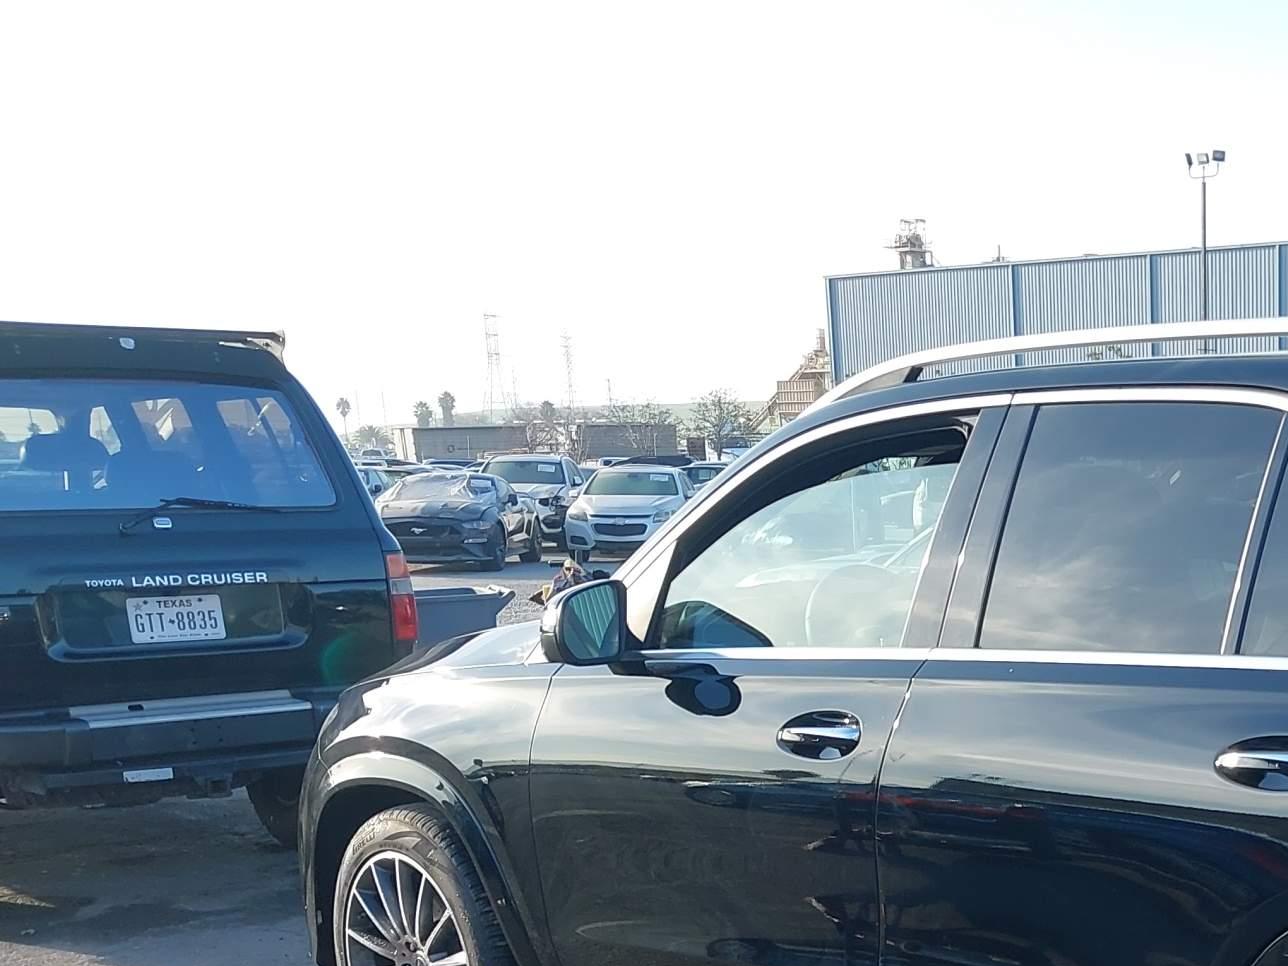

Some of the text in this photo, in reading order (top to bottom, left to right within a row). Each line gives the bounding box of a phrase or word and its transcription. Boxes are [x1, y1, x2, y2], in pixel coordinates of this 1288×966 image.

[85, 571, 268, 588] TOYOTA LAND CRUISER
[156, 599, 193, 609] TEXAS
[134, 610, 218, 633] GTT 8835
